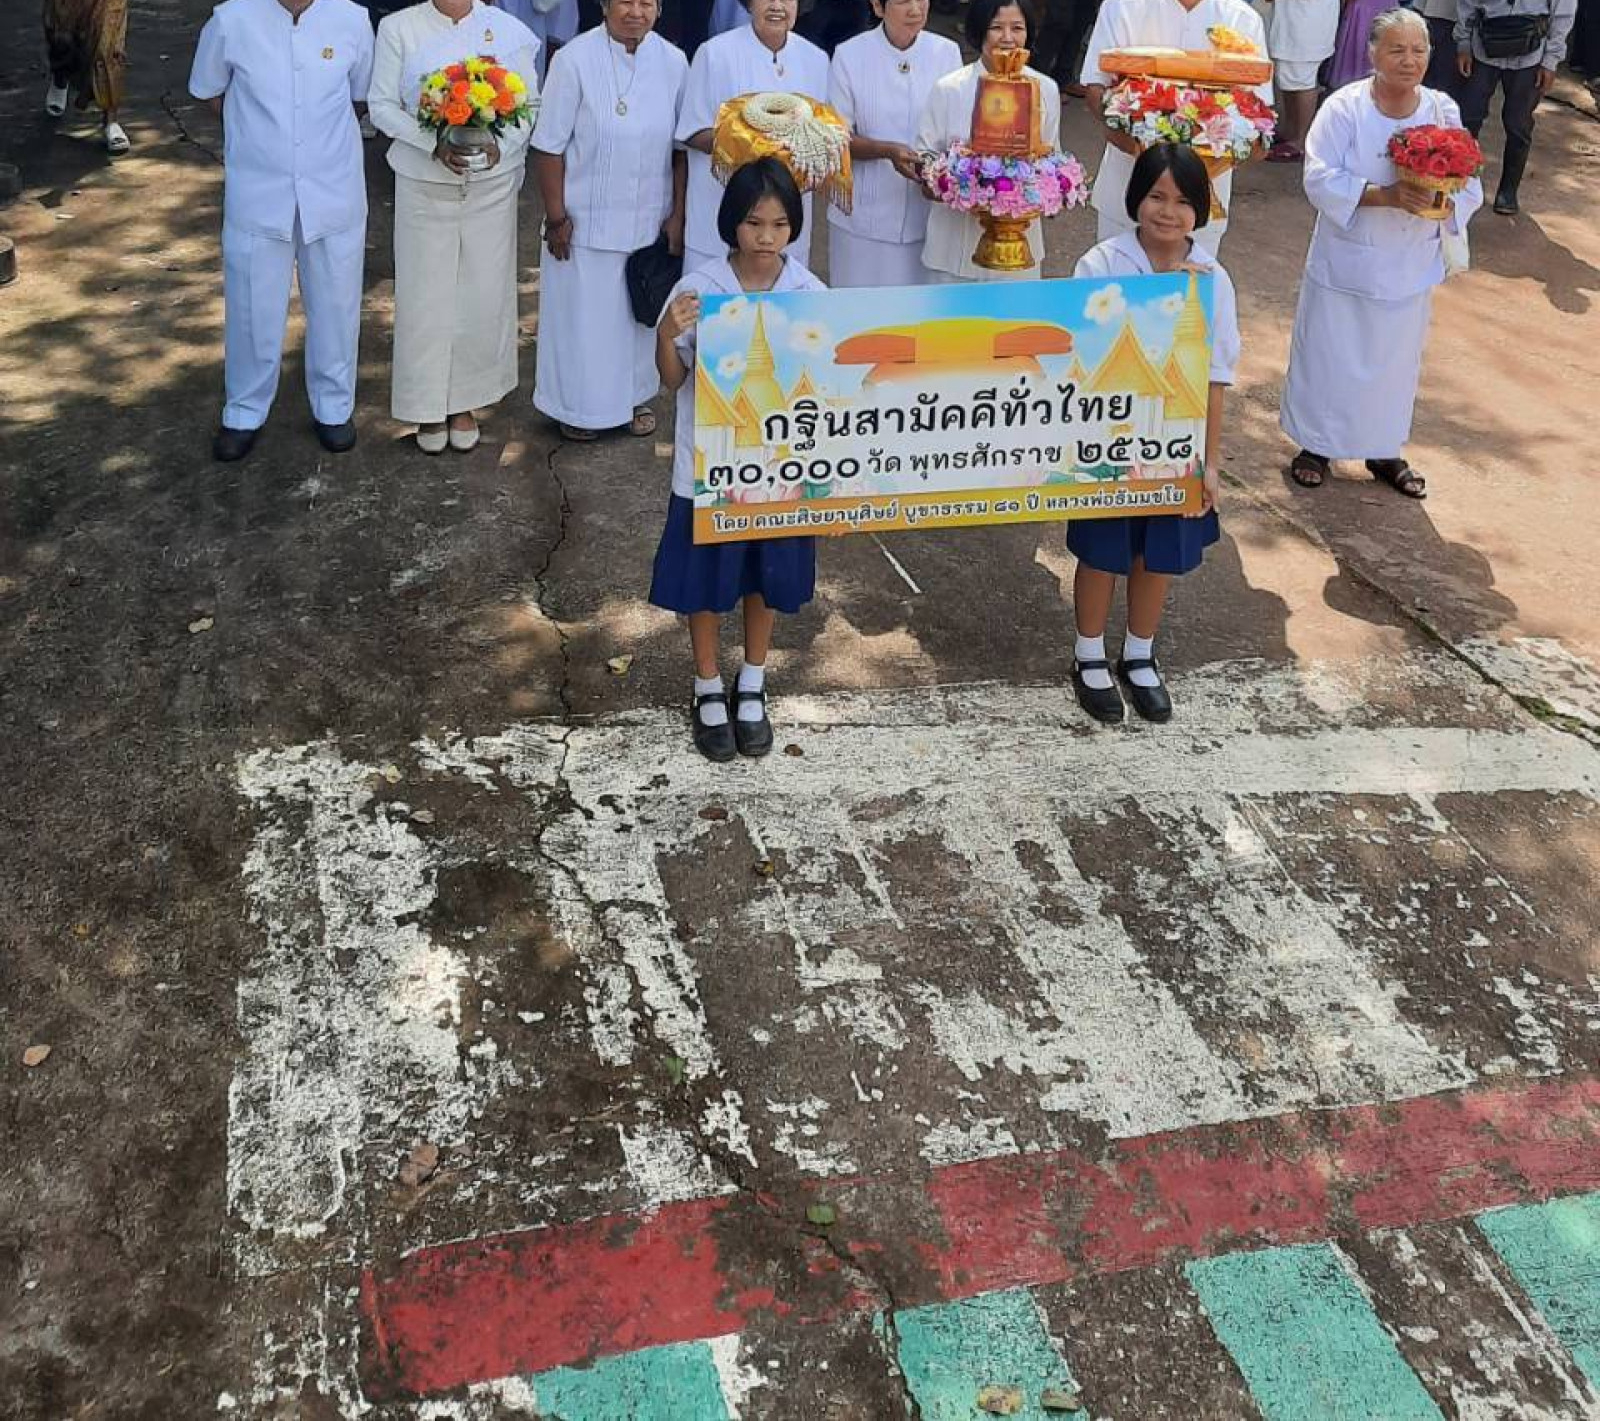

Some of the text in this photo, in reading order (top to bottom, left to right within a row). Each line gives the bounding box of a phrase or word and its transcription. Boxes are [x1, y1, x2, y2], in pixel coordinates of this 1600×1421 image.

[764, 375, 1133, 452] กฐินสามัคคีทั่วไทย
[708, 434, 1193, 488] ๓๐,๐๐๐ วัด พุทธศักราช ๒๕๖๘
[714, 485, 1184, 531] โดย คณะศิษยานุศิษย์ บูชาธรรม ๘๑ ปี หลวงพ่อธัมมชโย
